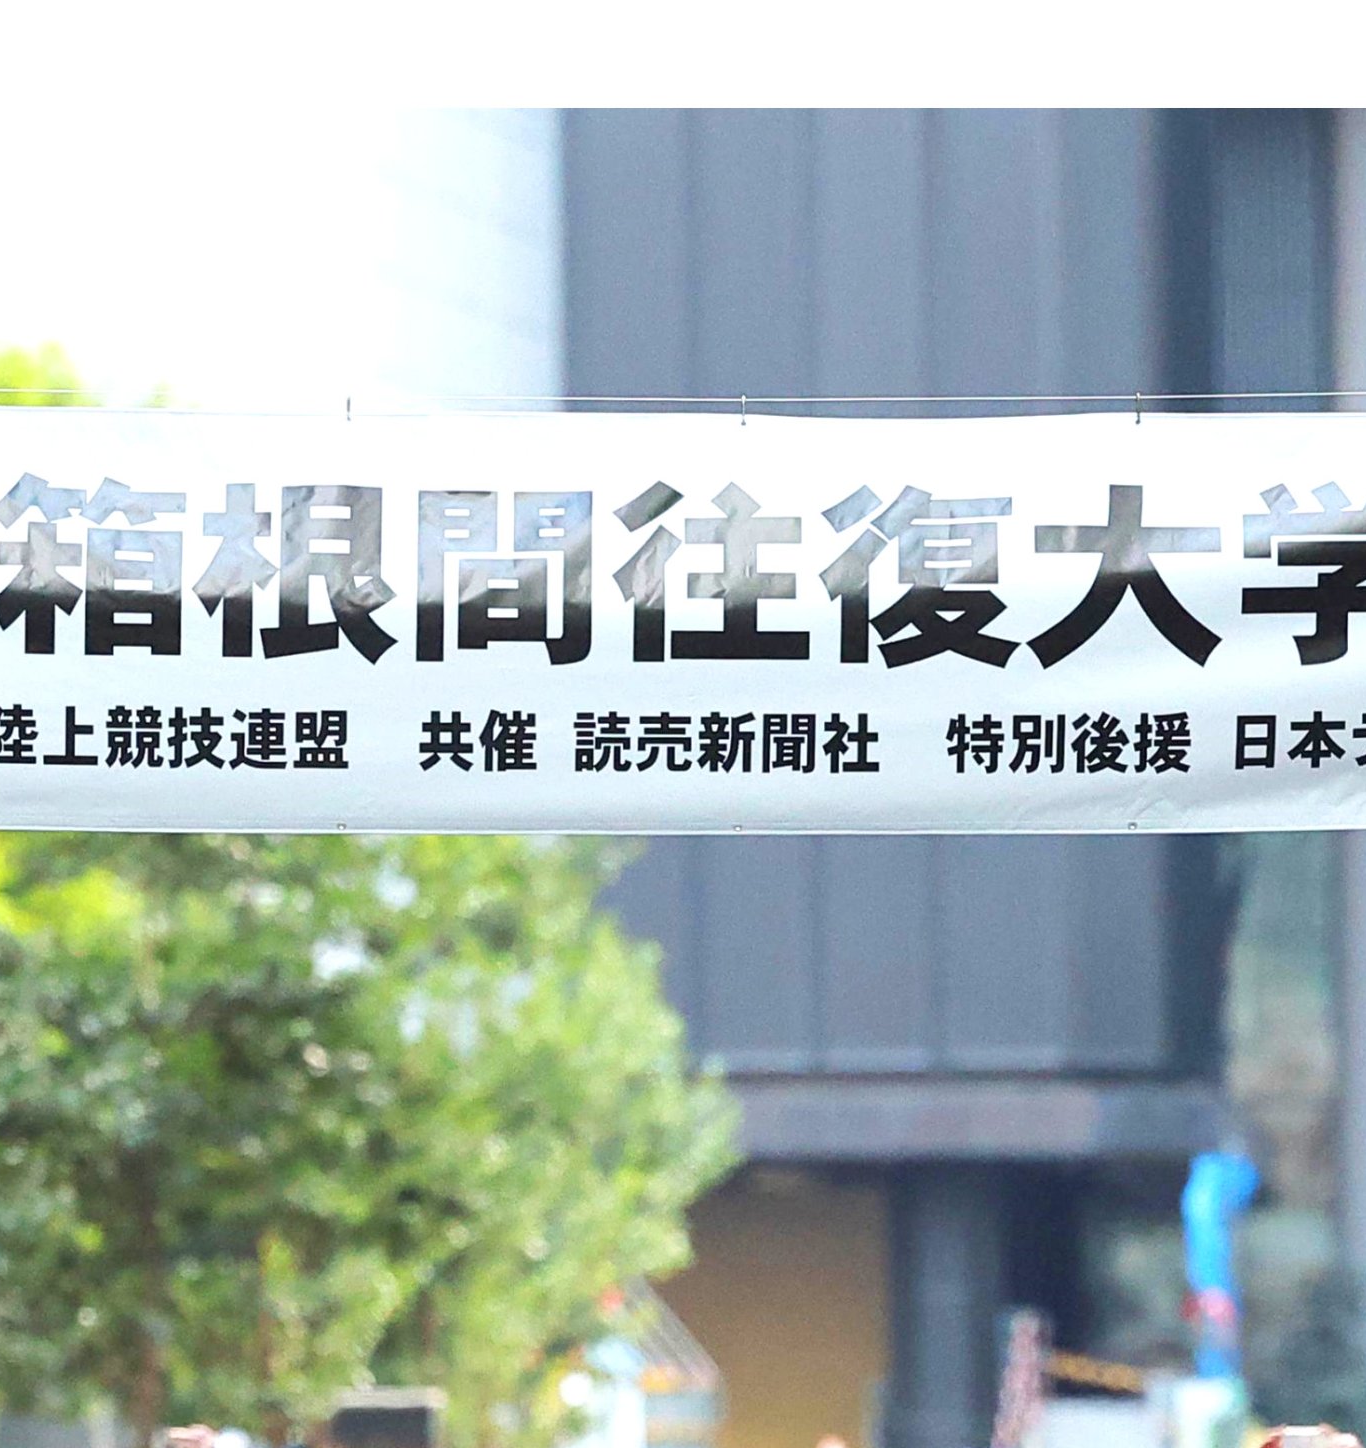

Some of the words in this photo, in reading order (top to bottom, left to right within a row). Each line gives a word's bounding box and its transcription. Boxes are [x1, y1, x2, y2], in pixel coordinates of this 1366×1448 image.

[418, 709, 537, 773] 共催
[574, 711, 880, 775] 読売新聞社
[946, 712, 1191, 775] 特別後援
